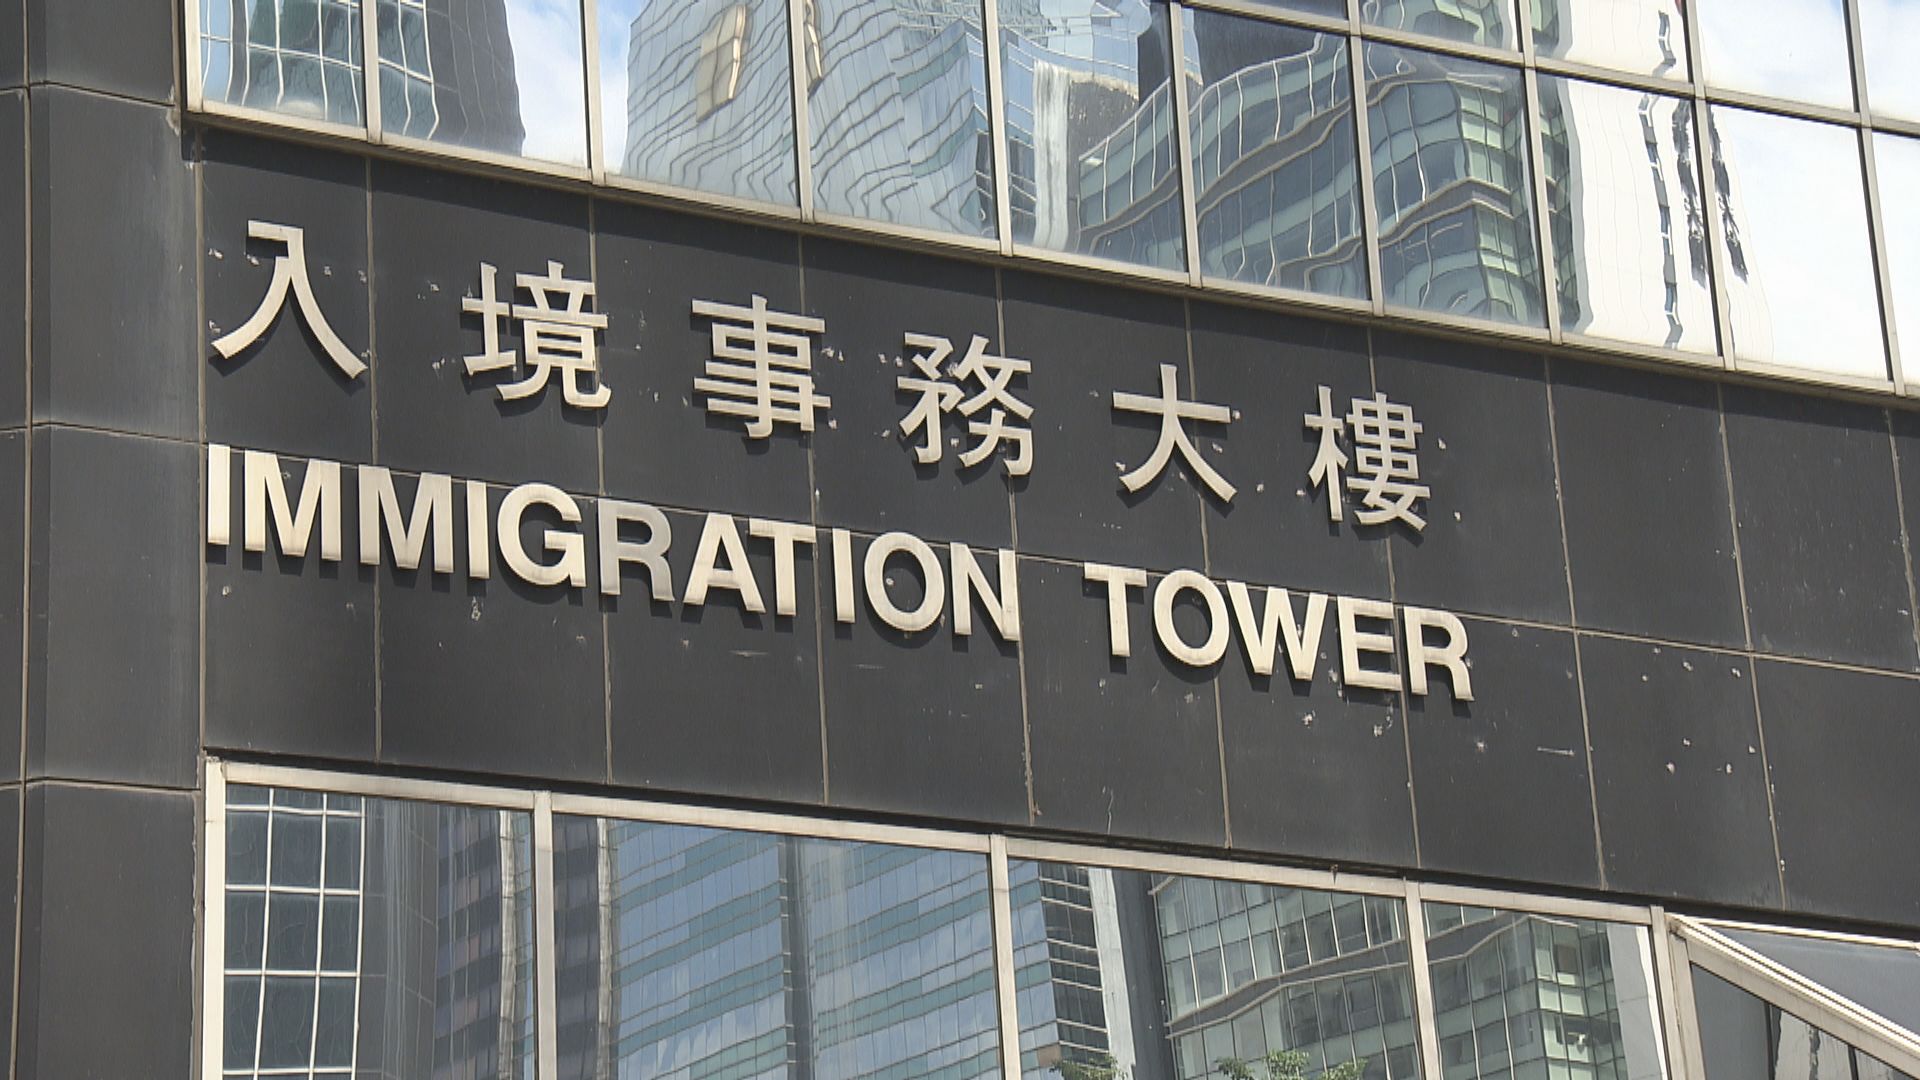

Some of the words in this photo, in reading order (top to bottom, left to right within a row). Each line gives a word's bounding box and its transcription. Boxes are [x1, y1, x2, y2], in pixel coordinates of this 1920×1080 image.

[211, 220, 1432, 532] 入境事務大樓
[206, 442, 1022, 642] IMMIGRATION
[1083, 561, 1475, 701] TOWER
